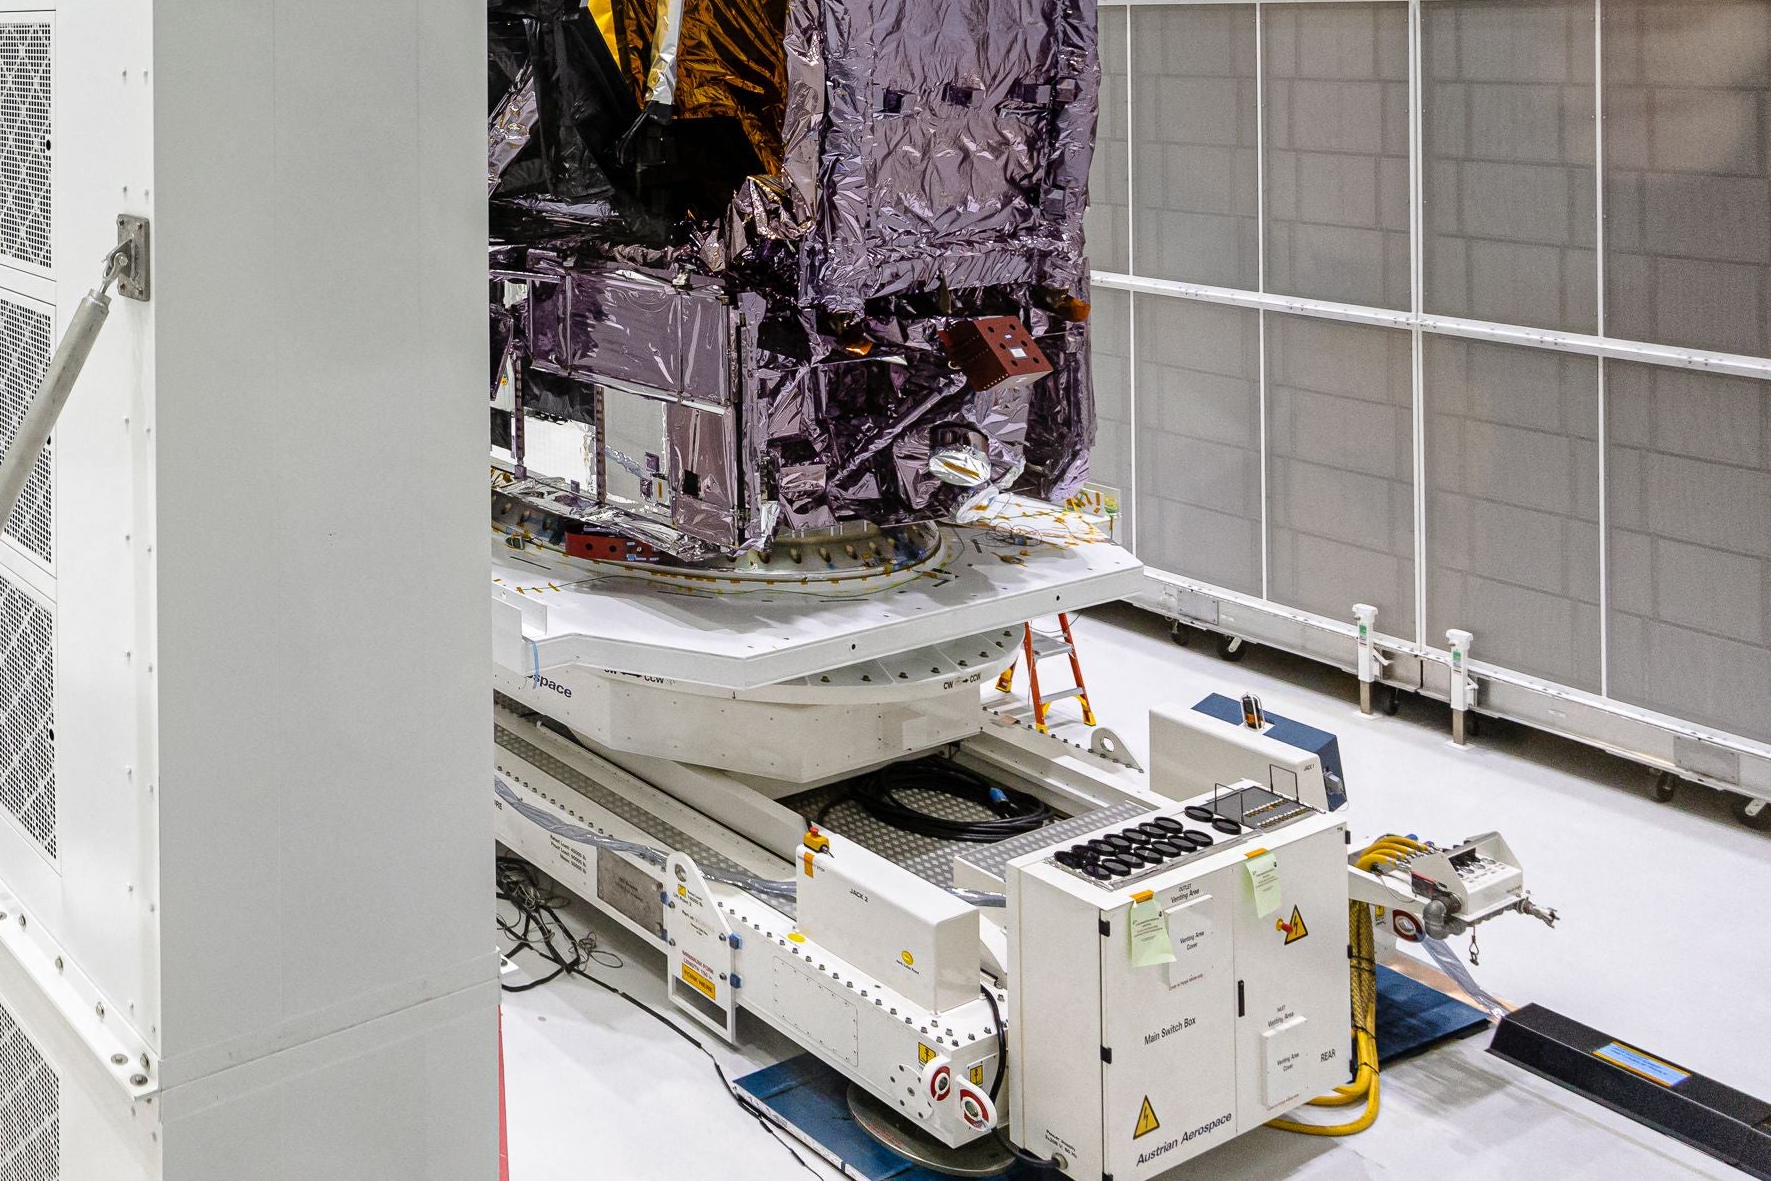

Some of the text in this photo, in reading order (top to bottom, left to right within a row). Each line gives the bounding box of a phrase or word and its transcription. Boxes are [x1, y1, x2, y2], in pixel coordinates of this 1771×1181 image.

[524, 674, 572, 698] space
[1170, 888, 1200, 904] Venting Area
[1179, 930, 1205, 945] Venting Area
[1186, 942, 1198, 951] Cover
[1144, 1017, 1196, 1045] Main Switch Box
[1320, 1048, 1336, 1062] REAR
[1136, 1113, 1232, 1167] Austrian Aerospace
